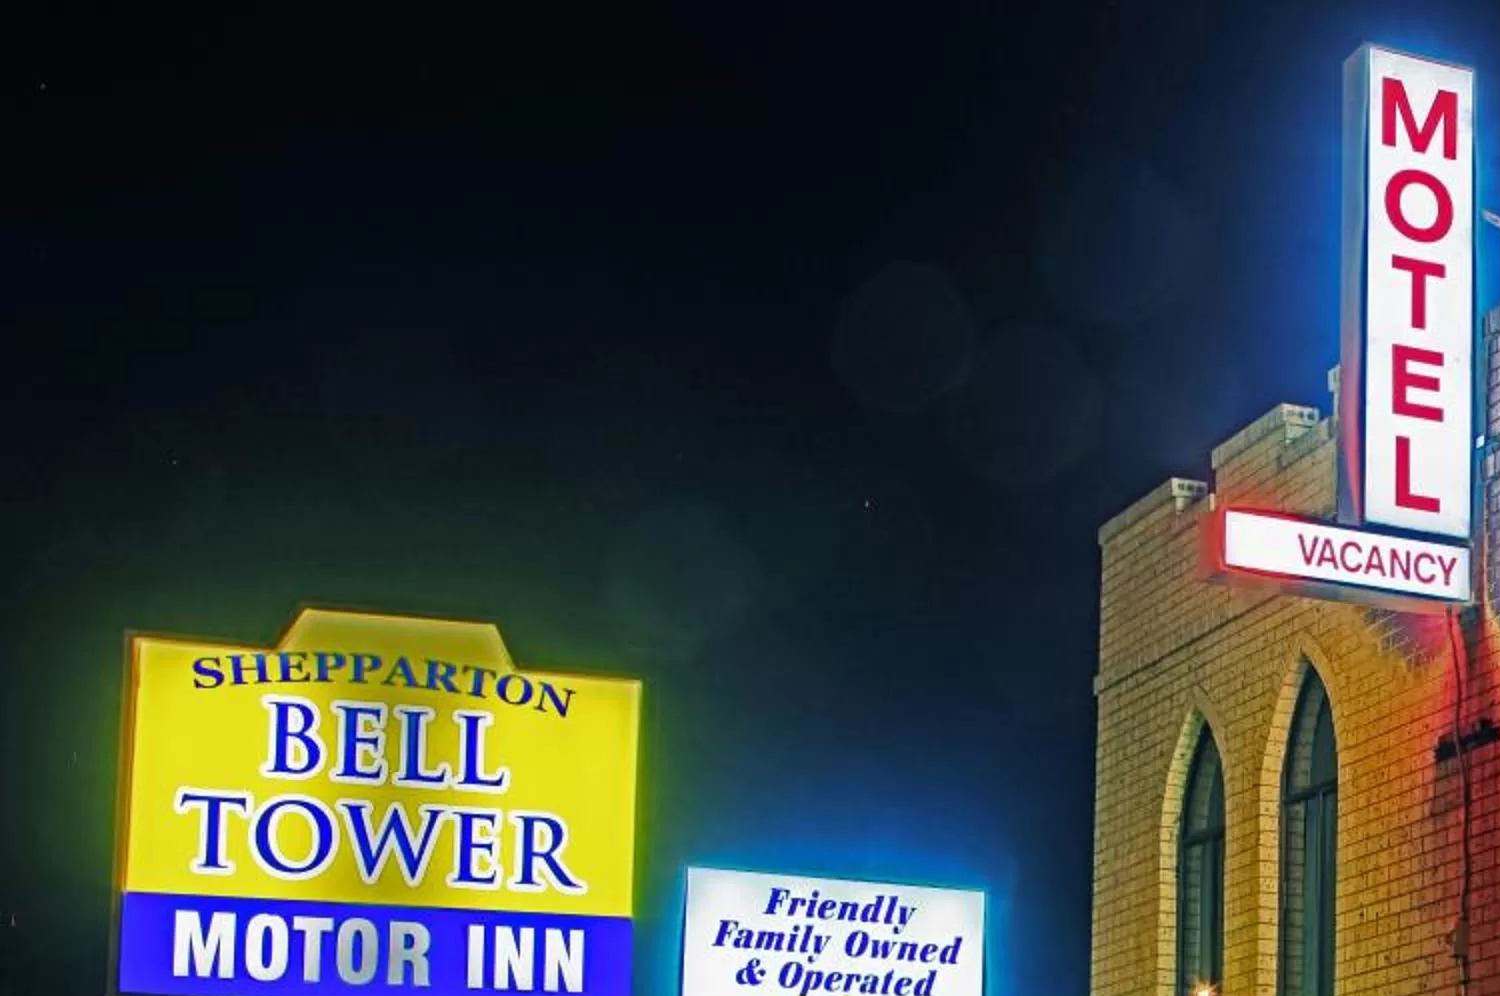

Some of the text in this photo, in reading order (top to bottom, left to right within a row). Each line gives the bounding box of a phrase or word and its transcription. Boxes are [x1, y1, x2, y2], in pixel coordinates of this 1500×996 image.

[1380, 75, 1460, 514] MOTEL
[1297, 533, 1458, 588] VACANCY
[192, 652, 577, 718] SHEPPARTON
[267, 700, 507, 787] BELL
[180, 793, 584, 889] TOWER
[712, 919, 963, 965] Family Owned
[763, 887, 917, 934] Friendly
[172, 909, 586, 993] MOTOR INN
[735, 957, 767, 986] &
